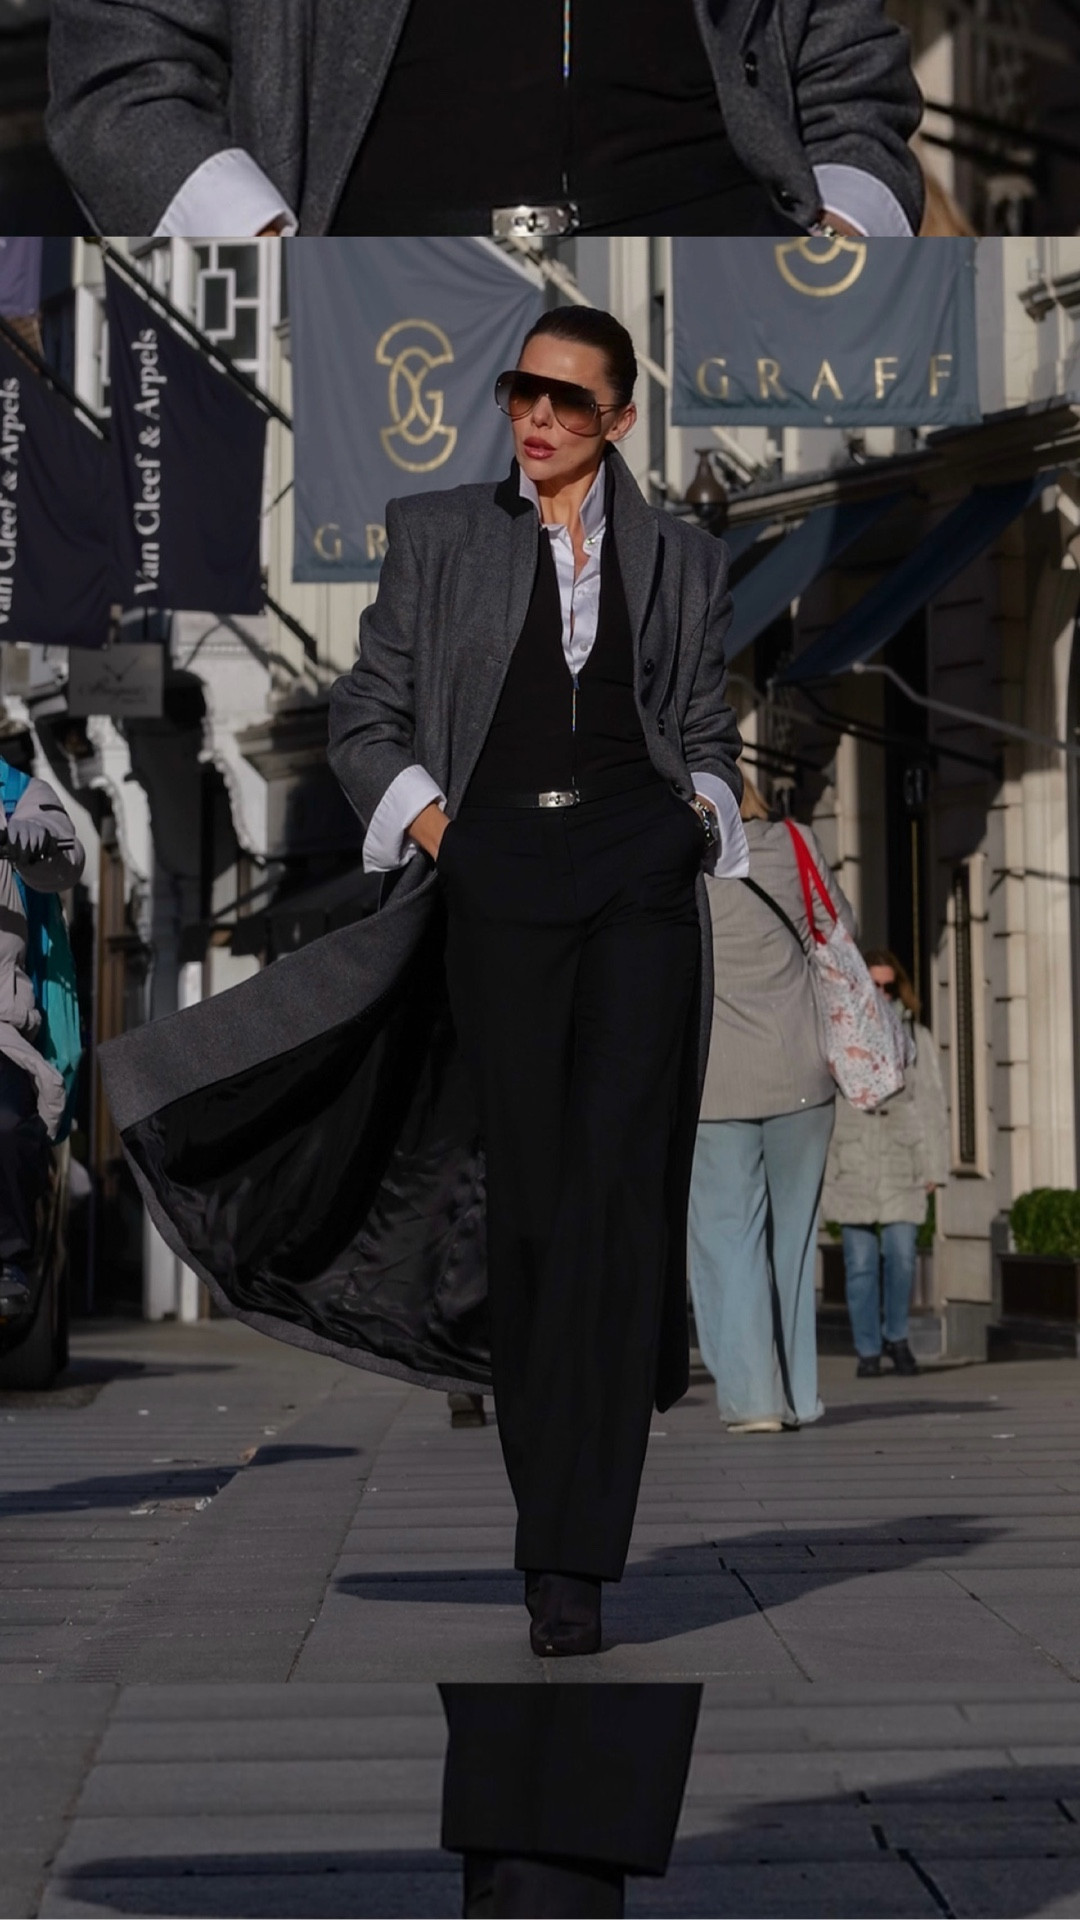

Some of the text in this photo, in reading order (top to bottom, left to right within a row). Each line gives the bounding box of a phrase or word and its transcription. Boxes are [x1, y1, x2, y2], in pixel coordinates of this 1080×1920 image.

[696, 353, 953, 401] GRAFF
[0, 378, 26, 466] Arpels
[1, 470, 18, 491] &
[131, 328, 168, 595] Van Cleef & Arpels
[314, 523, 388, 561] GR
